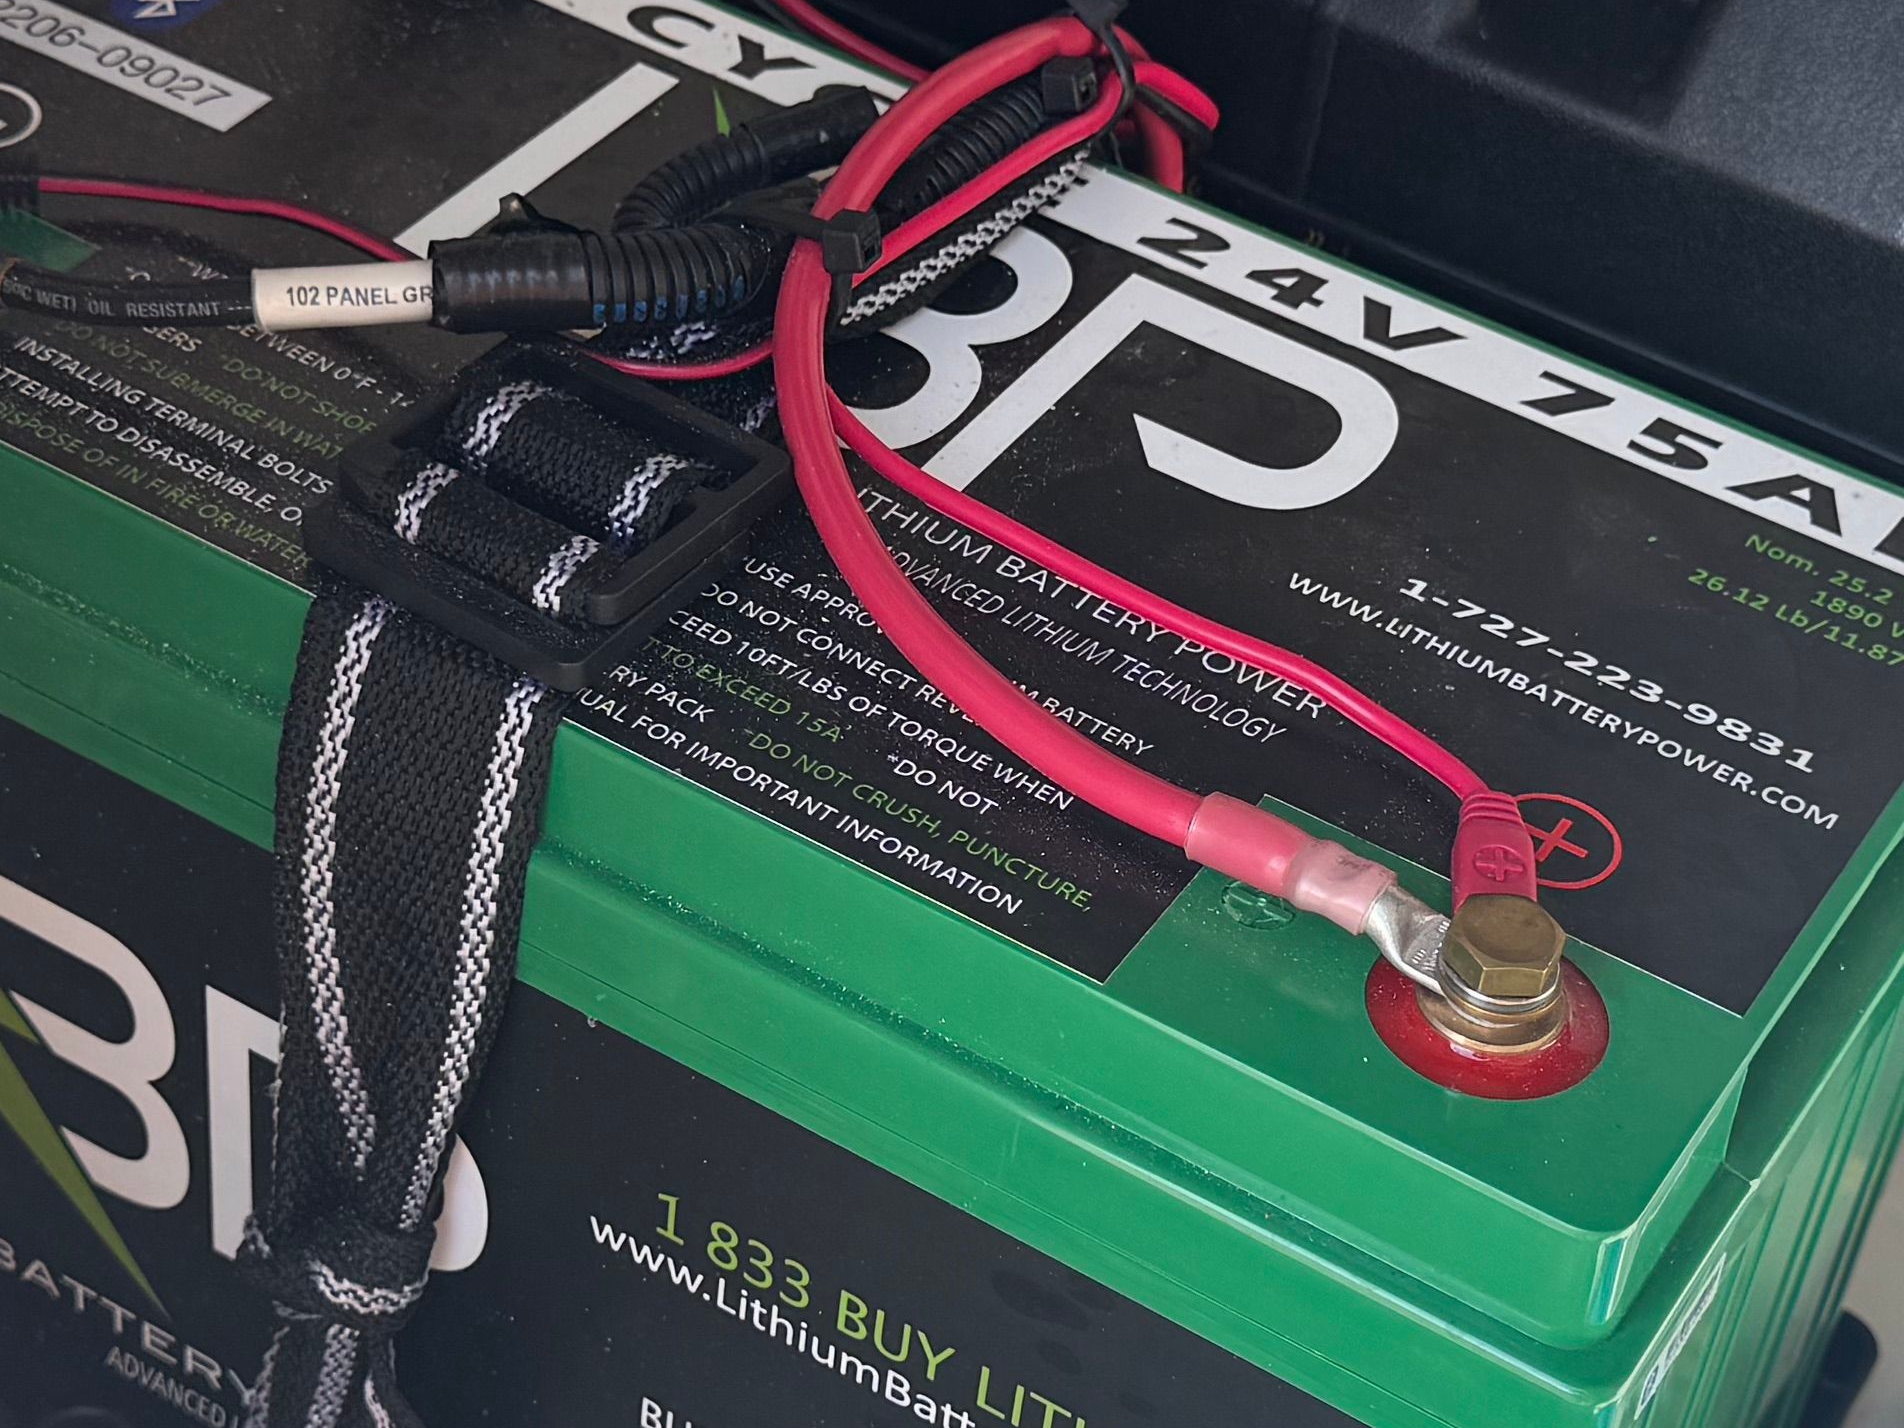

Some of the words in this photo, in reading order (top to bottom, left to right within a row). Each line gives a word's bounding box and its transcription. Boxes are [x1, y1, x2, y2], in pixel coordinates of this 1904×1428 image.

[88, 299, 115, 317] OIL
[126, 300, 220, 318] RESISTANT
[286, 286, 320, 307] 102
[327, 286, 397, 307] PANEL
[1136, 218, 1468, 352] 24V
[14, 335, 148, 406] INSTALLING
[144, 396, 256, 460] TERMINAL
[256, 452, 335, 495] BOLTS
[146, 358, 267, 423] SUBMERGE
[82, 447, 120, 470] OF
[116, 462, 149, 486] IN
[146, 478, 202, 510] FIRE
[198, 503, 235, 529] OR
[87, 409, 119, 434] TO
[116, 425, 275, 514] DISASSEMBLE,
[857, 488, 994, 565] ITHIUM
[996, 553, 1171, 644] BATTERY
[1174, 637, 1328, 719] POWER
[1687, 568, 1771, 612] 26.12
[1744, 533, 1819, 576] Nom.
[1828, 569, 1895, 606] 25.2
[1809, 590, 1883, 629] 1890
[738, 600, 802, 634] NOT
[796, 627, 918, 691] CONNECT
[887, 546, 1002, 617] DVANCED
[1001, 605, 1116, 667] LITHIUM
[1111, 653, 1288, 745] TECHNOLOGY
[1399, 577, 1814, 774] 1-727-223-9831
[696, 662, 791, 715] EXCEED
[936, 778, 1000, 818] NOT
[735, 638, 849, 702] 10FT/LBS
[848, 695, 887, 723] OF
[886, 711, 993, 771] TORQUE
[993, 764, 1074, 811] WHEN
[630, 715, 692, 754] FOR
[689, 738, 838, 824] IMPORTANT
[836, 812, 1024, 916] INFORMATION
[645, 680, 714, 724] PACK
[790, 748, 854, 789] NOT
[851, 784, 943, 841] CRUSH,
[945, 828, 1092, 912] PUNCTURE,
[655, 1192, 686, 1246] 1
[706, 1220, 811, 1310] 833
[835, 1289, 956, 1382] BUY
